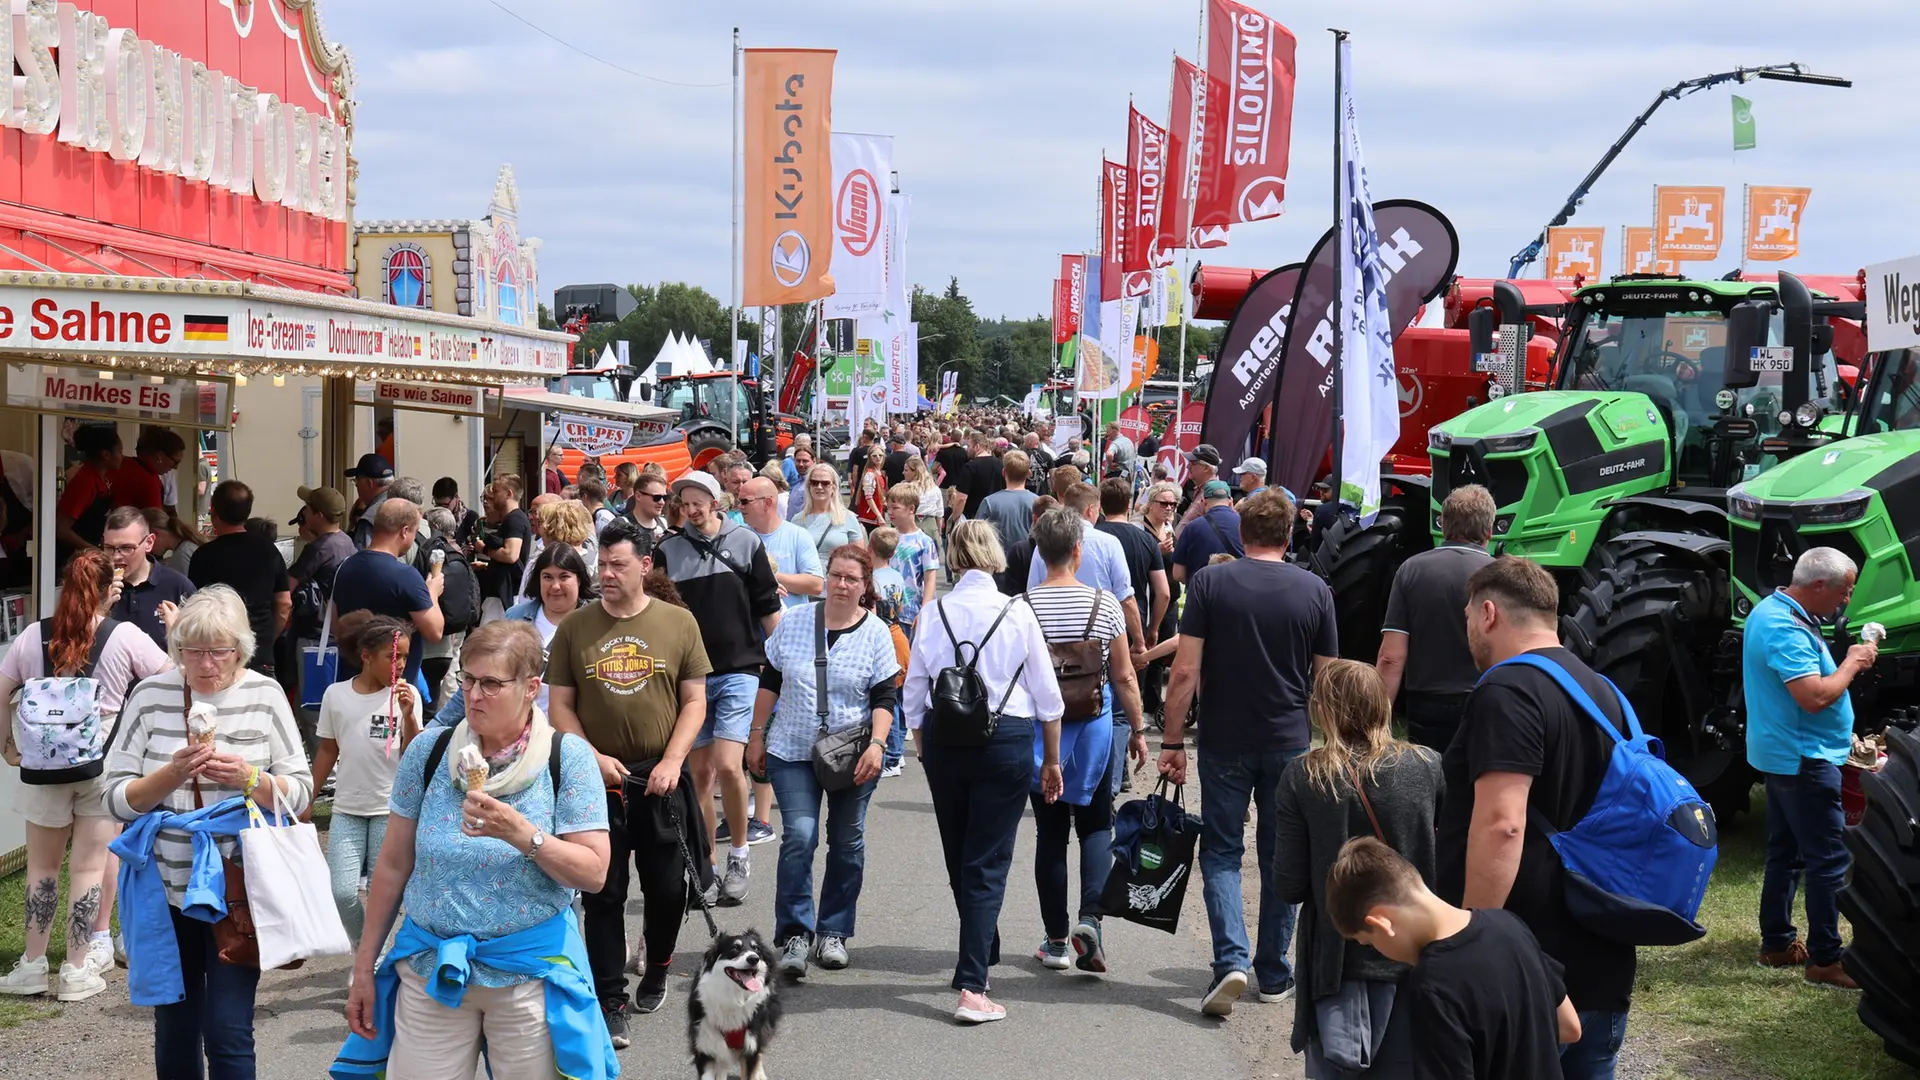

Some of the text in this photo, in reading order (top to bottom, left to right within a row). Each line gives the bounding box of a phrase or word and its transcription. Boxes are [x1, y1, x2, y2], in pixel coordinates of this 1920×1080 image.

[1234, 13, 1265, 166] SILOKING
[774, 74, 805, 219] Kubota
[1140, 120, 1163, 227] SILOKING
[840, 181, 868, 243] Vicon
[1070, 262, 1082, 313] HORSCH
[1622, 292, 1679, 300] DEUTZ-FAHR
[31, 298, 171, 344] Sahne
[1123, 314, 1132, 344] AGRO
[328, 318, 374, 356] Dondurma
[388, 327, 413, 359] Helado
[430, 331, 471, 362] Eis wie Sahne
[1484, 355, 1494, 363] WL
[1753, 360, 1790, 370] HK 950
[1759, 350, 1774, 359] WL
[1477, 363, 1486, 371] HK
[45, 377, 171, 409] Mankes Eis
[380, 384, 473, 405] Eis wie Sahne
[1120, 420, 1148, 431] SILOKNG
[587, 442, 614, 451] Kinder
[1600, 458, 1646, 476] DEUTZ-FAHR
[600, 635, 649, 653] ROCKY BEACH
[602, 658, 649, 672] TITUS JONAS
[603, 679, 648, 695] 45 SUNRISE ROAD
